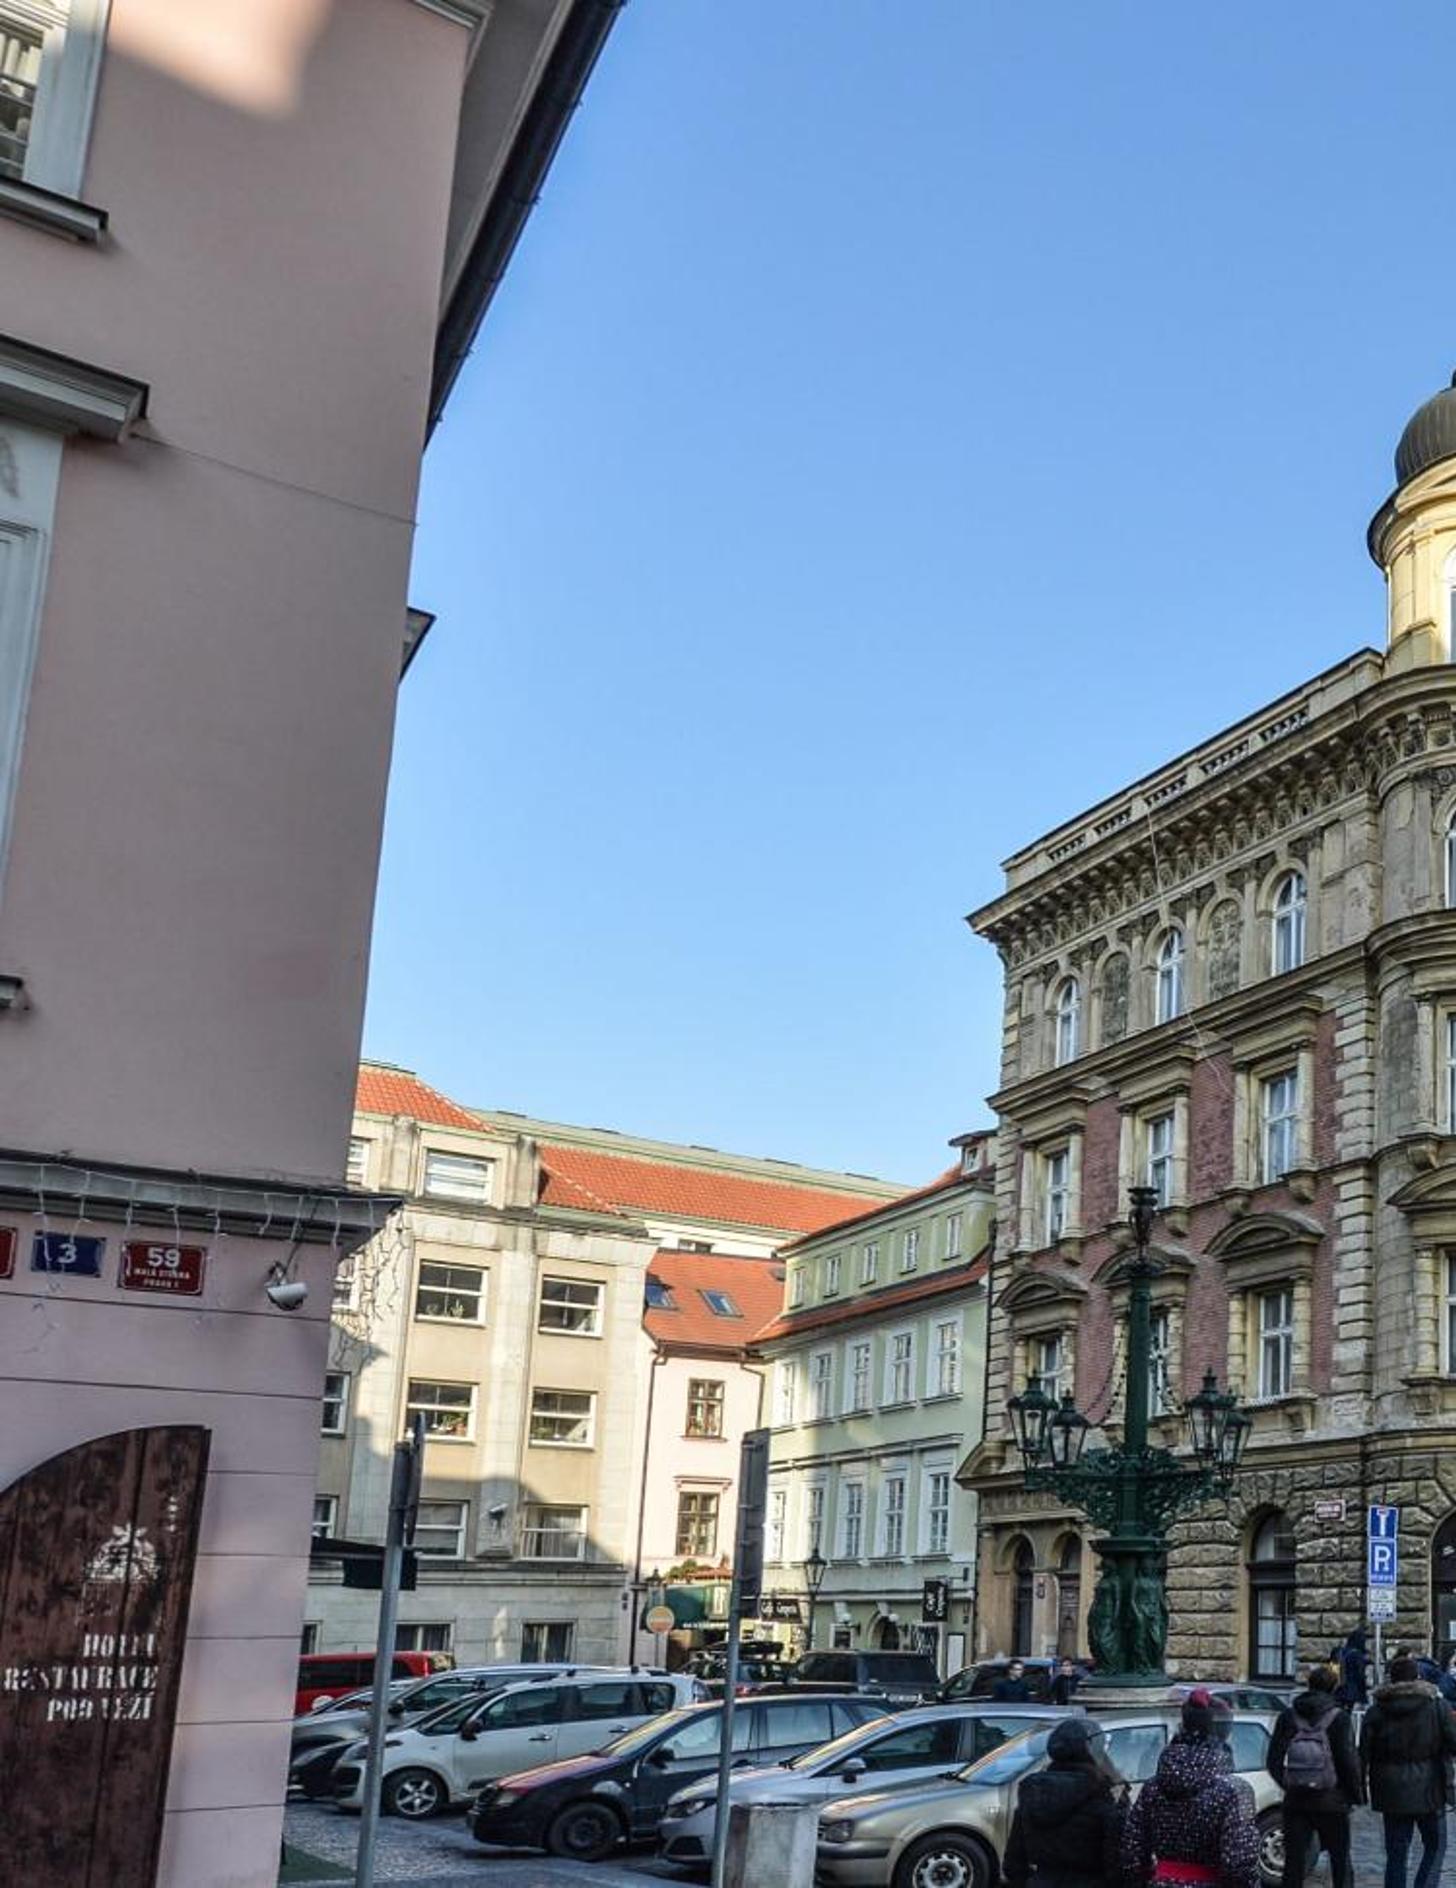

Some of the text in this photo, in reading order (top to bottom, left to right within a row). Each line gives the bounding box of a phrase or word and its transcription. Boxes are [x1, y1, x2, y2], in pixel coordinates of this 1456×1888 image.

[58, 1243, 77, 1263] 3
[148, 1247, 180, 1268] 59
[4, 1665, 159, 1690] RESTAURACE
